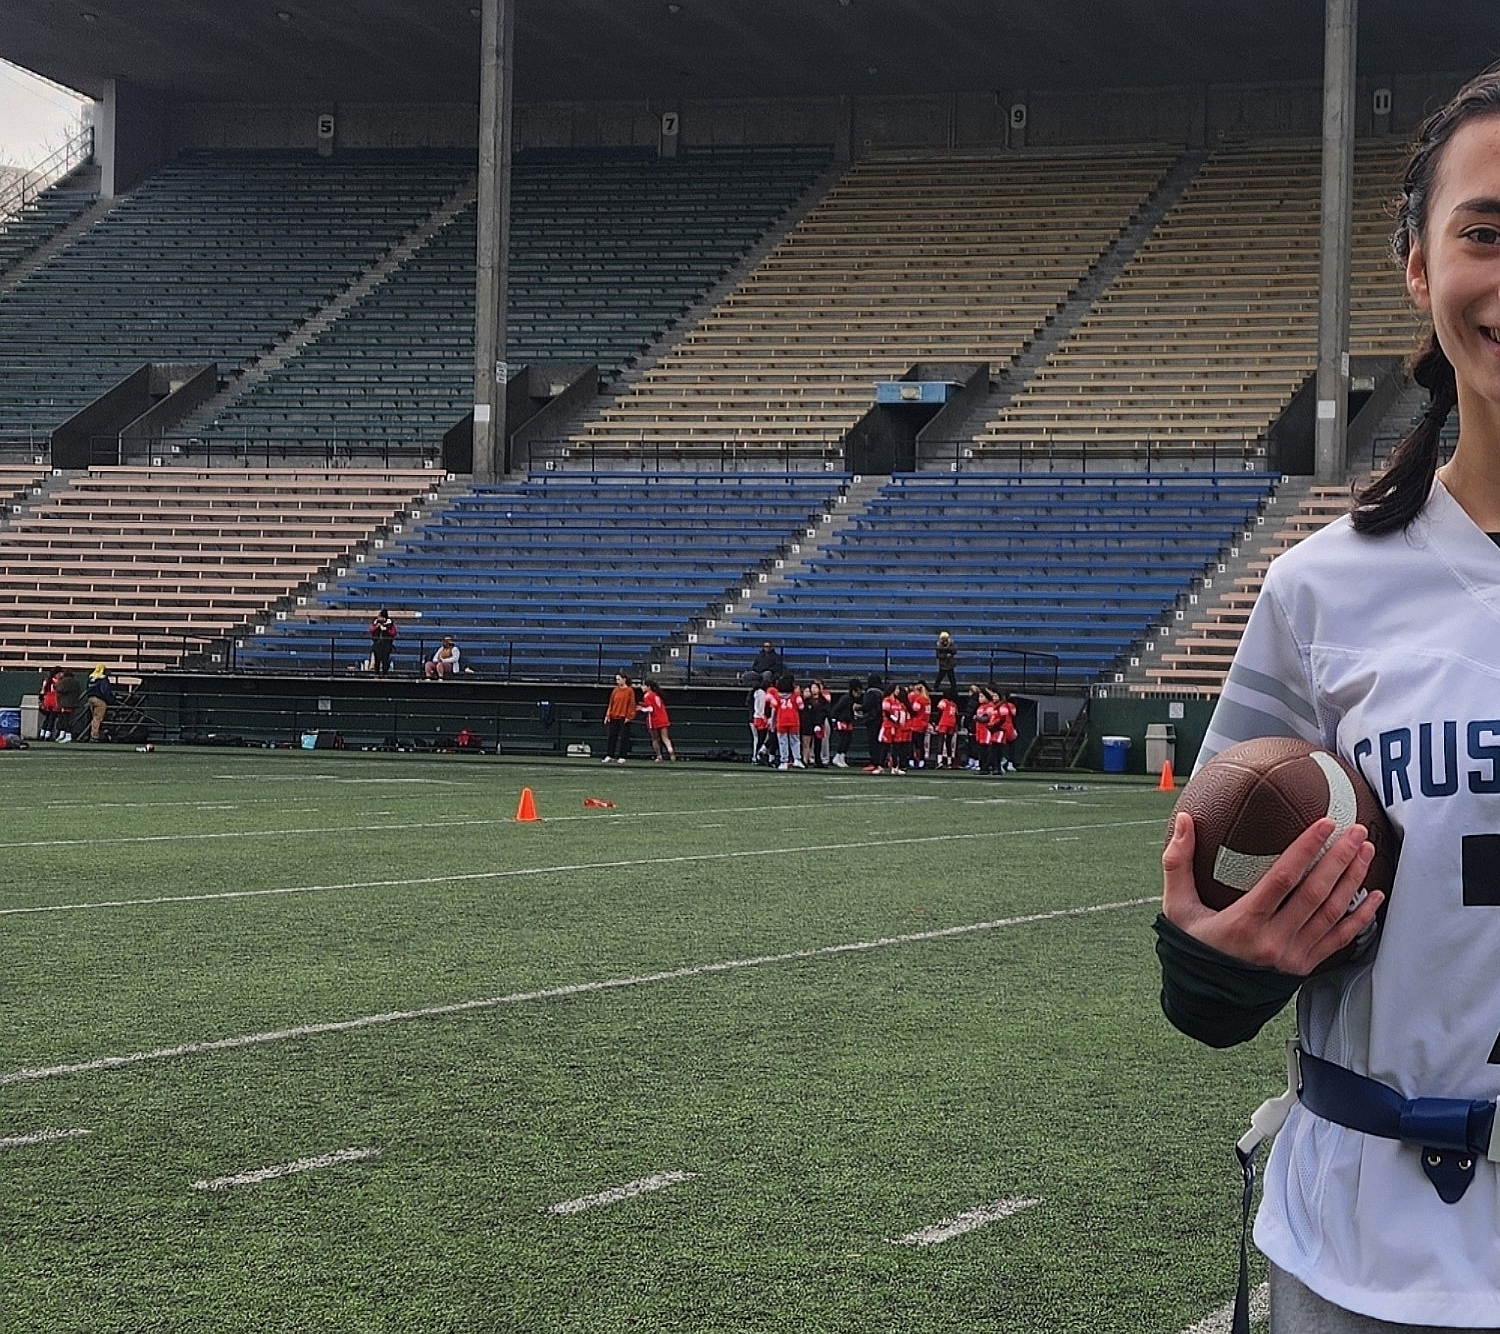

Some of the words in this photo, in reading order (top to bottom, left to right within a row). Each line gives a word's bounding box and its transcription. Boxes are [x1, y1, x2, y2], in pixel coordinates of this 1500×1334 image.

[1376, 95, 1389, 109] 11
[1014, 109, 1025, 123] 9
[320, 119, 332, 133] 5
[665, 118, 676, 131] 7
[780, 698, 793, 710] 24
